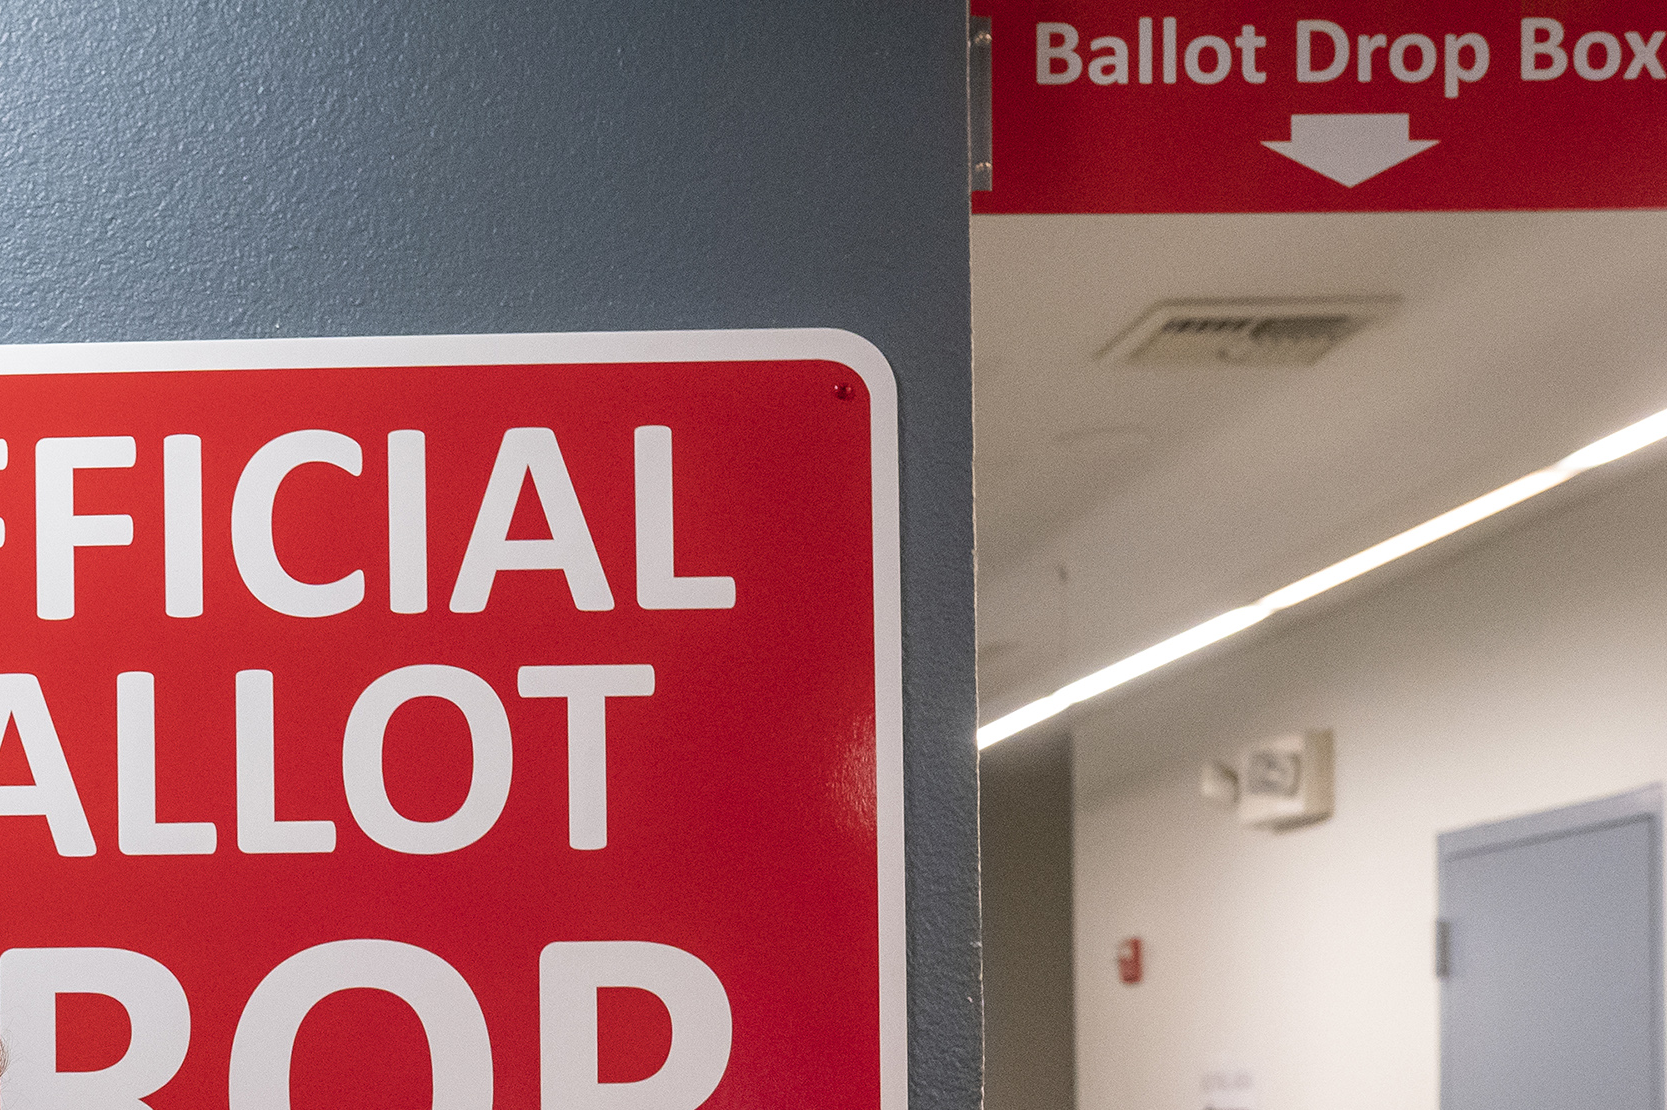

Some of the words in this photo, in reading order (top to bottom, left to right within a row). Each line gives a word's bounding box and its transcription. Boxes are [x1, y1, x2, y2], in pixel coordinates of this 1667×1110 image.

[1034, 16, 1267, 86] Ballot
[1295, 19, 1491, 99] Drop
[1520, 16, 1667, 83] Box
